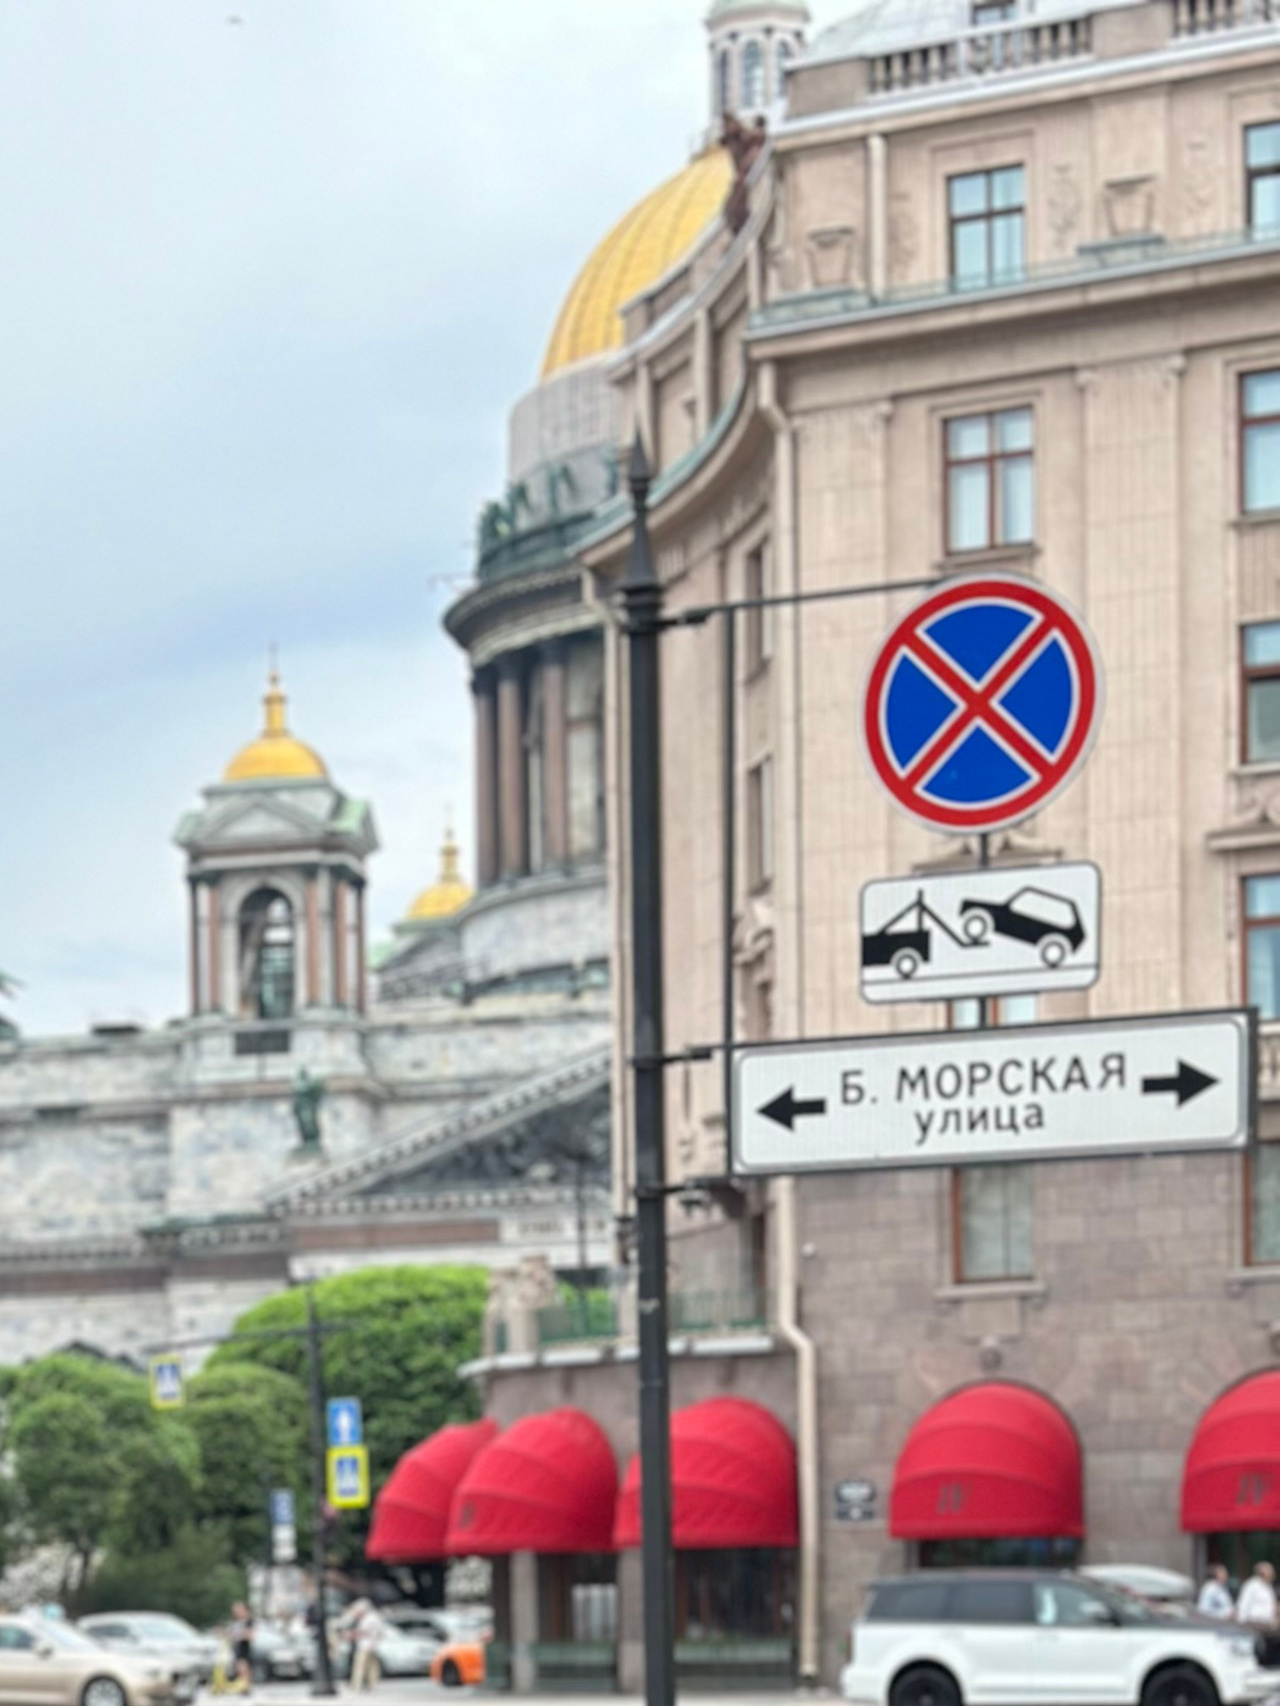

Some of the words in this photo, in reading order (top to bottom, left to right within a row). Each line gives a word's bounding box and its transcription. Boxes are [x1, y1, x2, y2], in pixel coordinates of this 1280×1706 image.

[840, 1070, 877, 1105] Б.
[896, 1052, 1127, 1102] МОРСКАЯ
[914, 1103, 1046, 1145] улица
